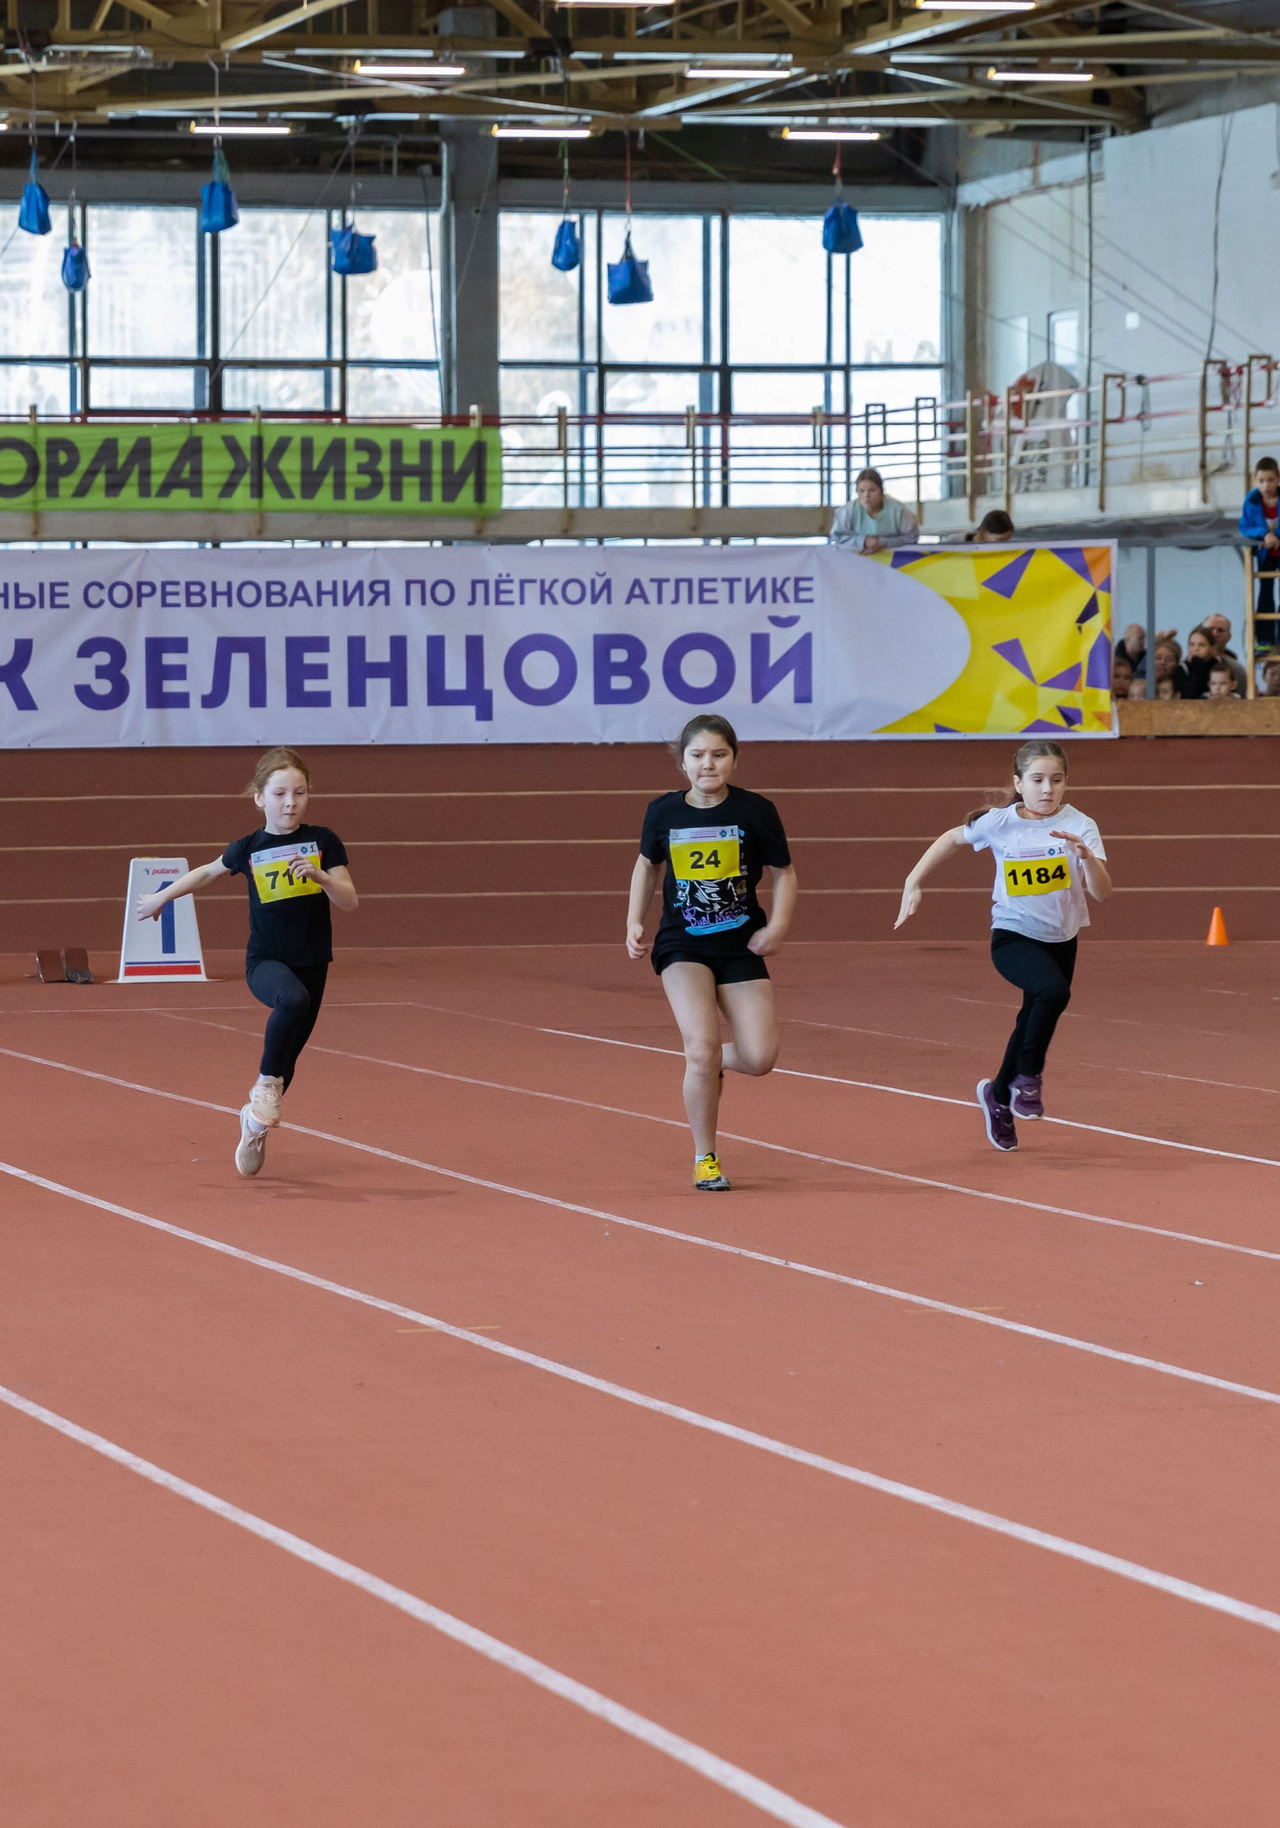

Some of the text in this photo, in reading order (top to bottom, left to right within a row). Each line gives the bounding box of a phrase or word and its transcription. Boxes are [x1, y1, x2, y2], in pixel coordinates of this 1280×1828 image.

[218, 435, 487, 502] ЖИЗНИ
[82, 579, 391, 609] СОРЕВНОВАНИЯ
[404, 578, 456, 606] ПО
[467, 572, 613, 606] ЛЁГКОЙ
[624, 576, 815, 605] АТЛЕТИКЕ
[73, 615, 813, 721] ЗЕЛЕНЦОВОЙ
[152, 866, 180, 875] polanik
[689, 849, 721, 870] 24
[1008, 865, 1066, 886] 1184
[154, 881, 176, 954] 1
